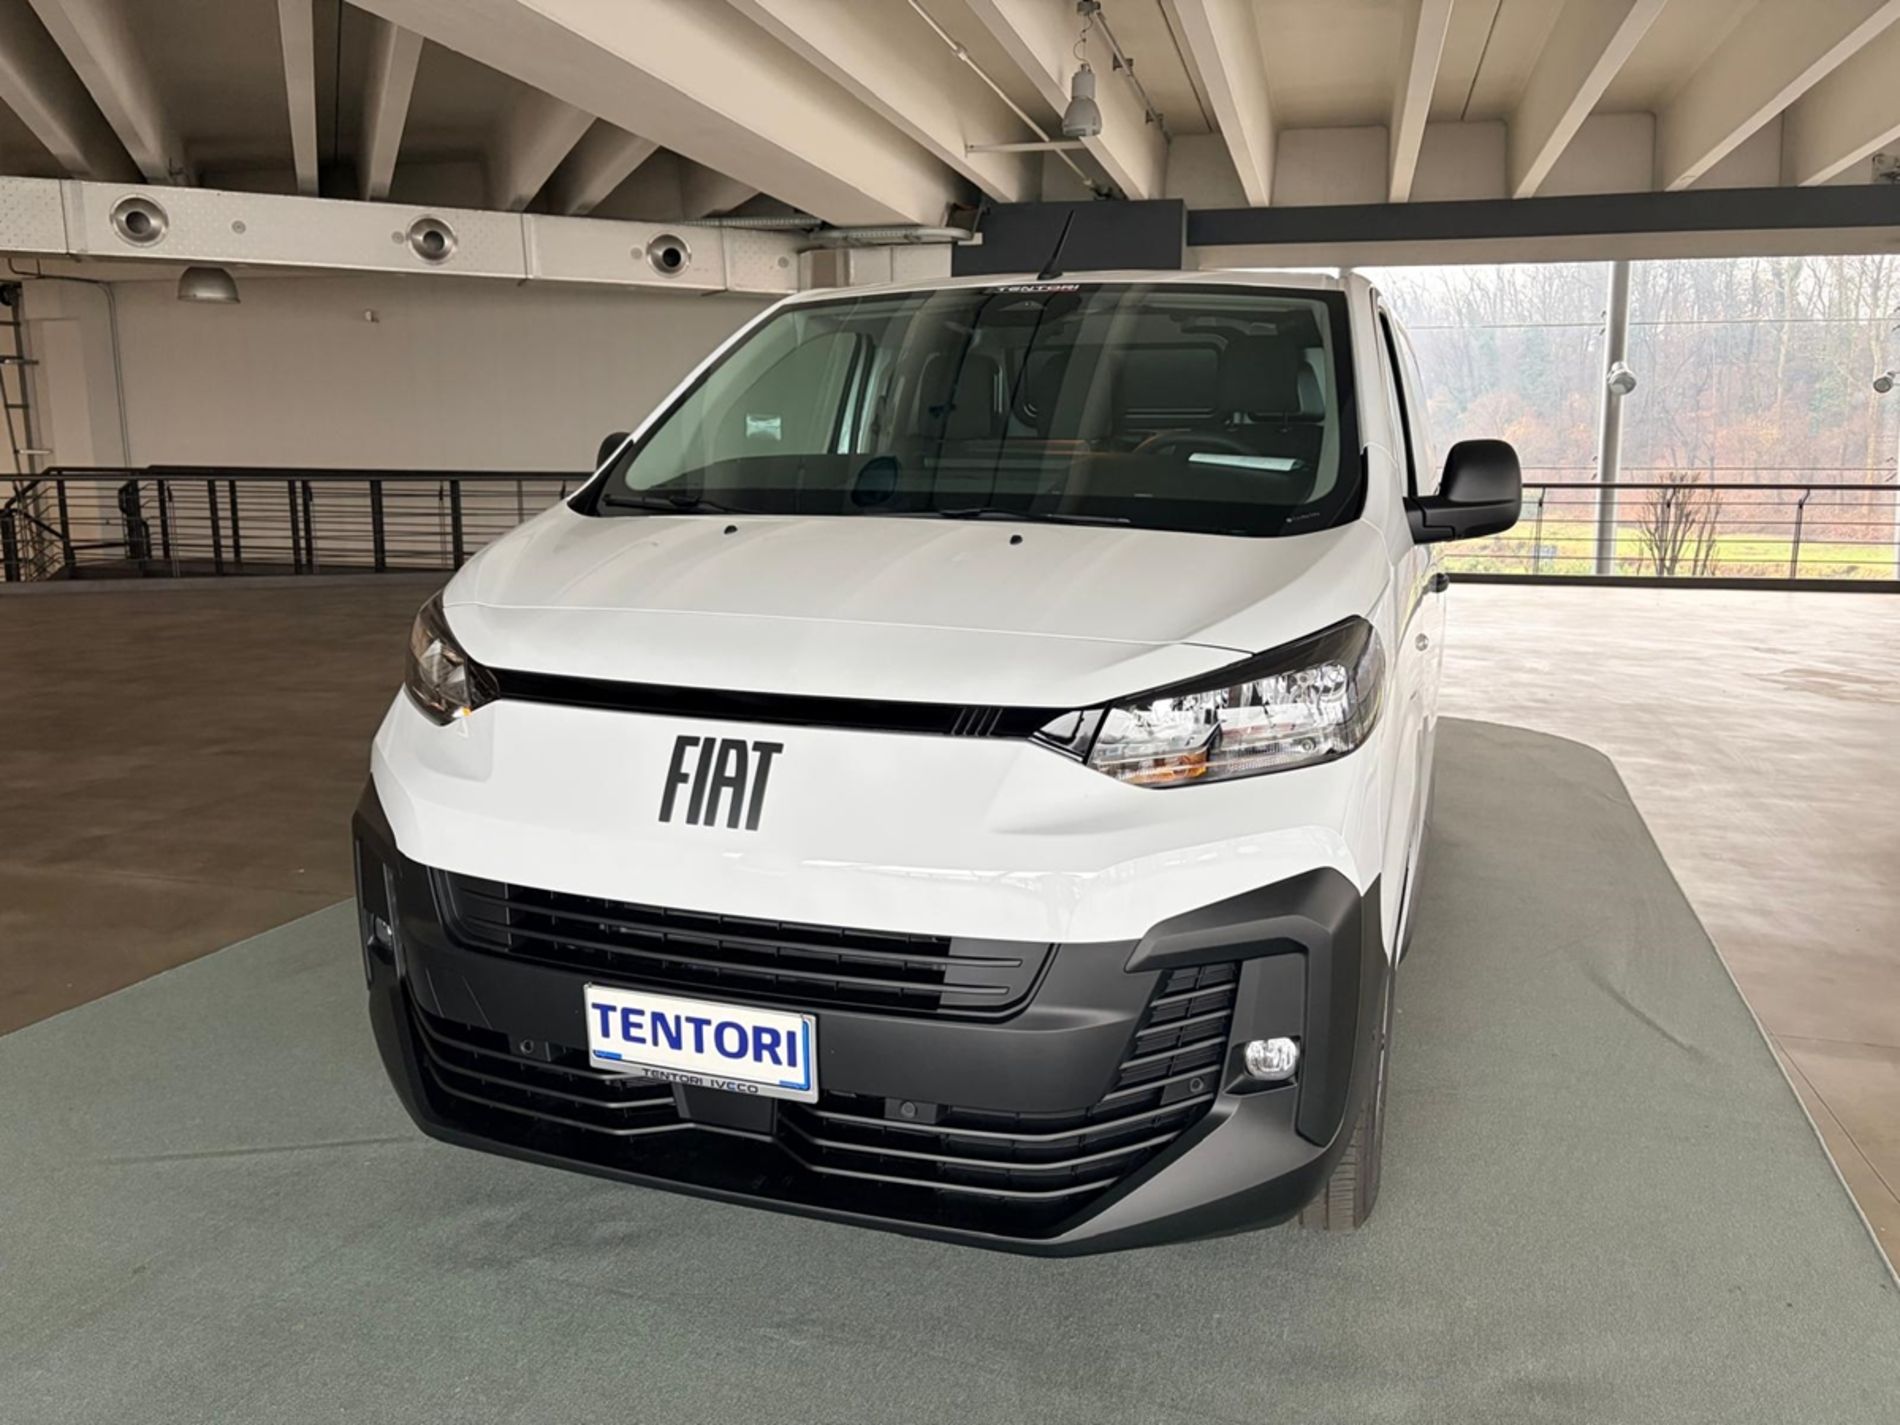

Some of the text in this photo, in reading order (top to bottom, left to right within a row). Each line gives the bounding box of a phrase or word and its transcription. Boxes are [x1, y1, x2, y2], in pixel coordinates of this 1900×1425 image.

[658, 735, 784, 831] FIAT
[591, 1003, 797, 1067] TENTORI
[642, 1068, 759, 1094] TENTORI IVECO
